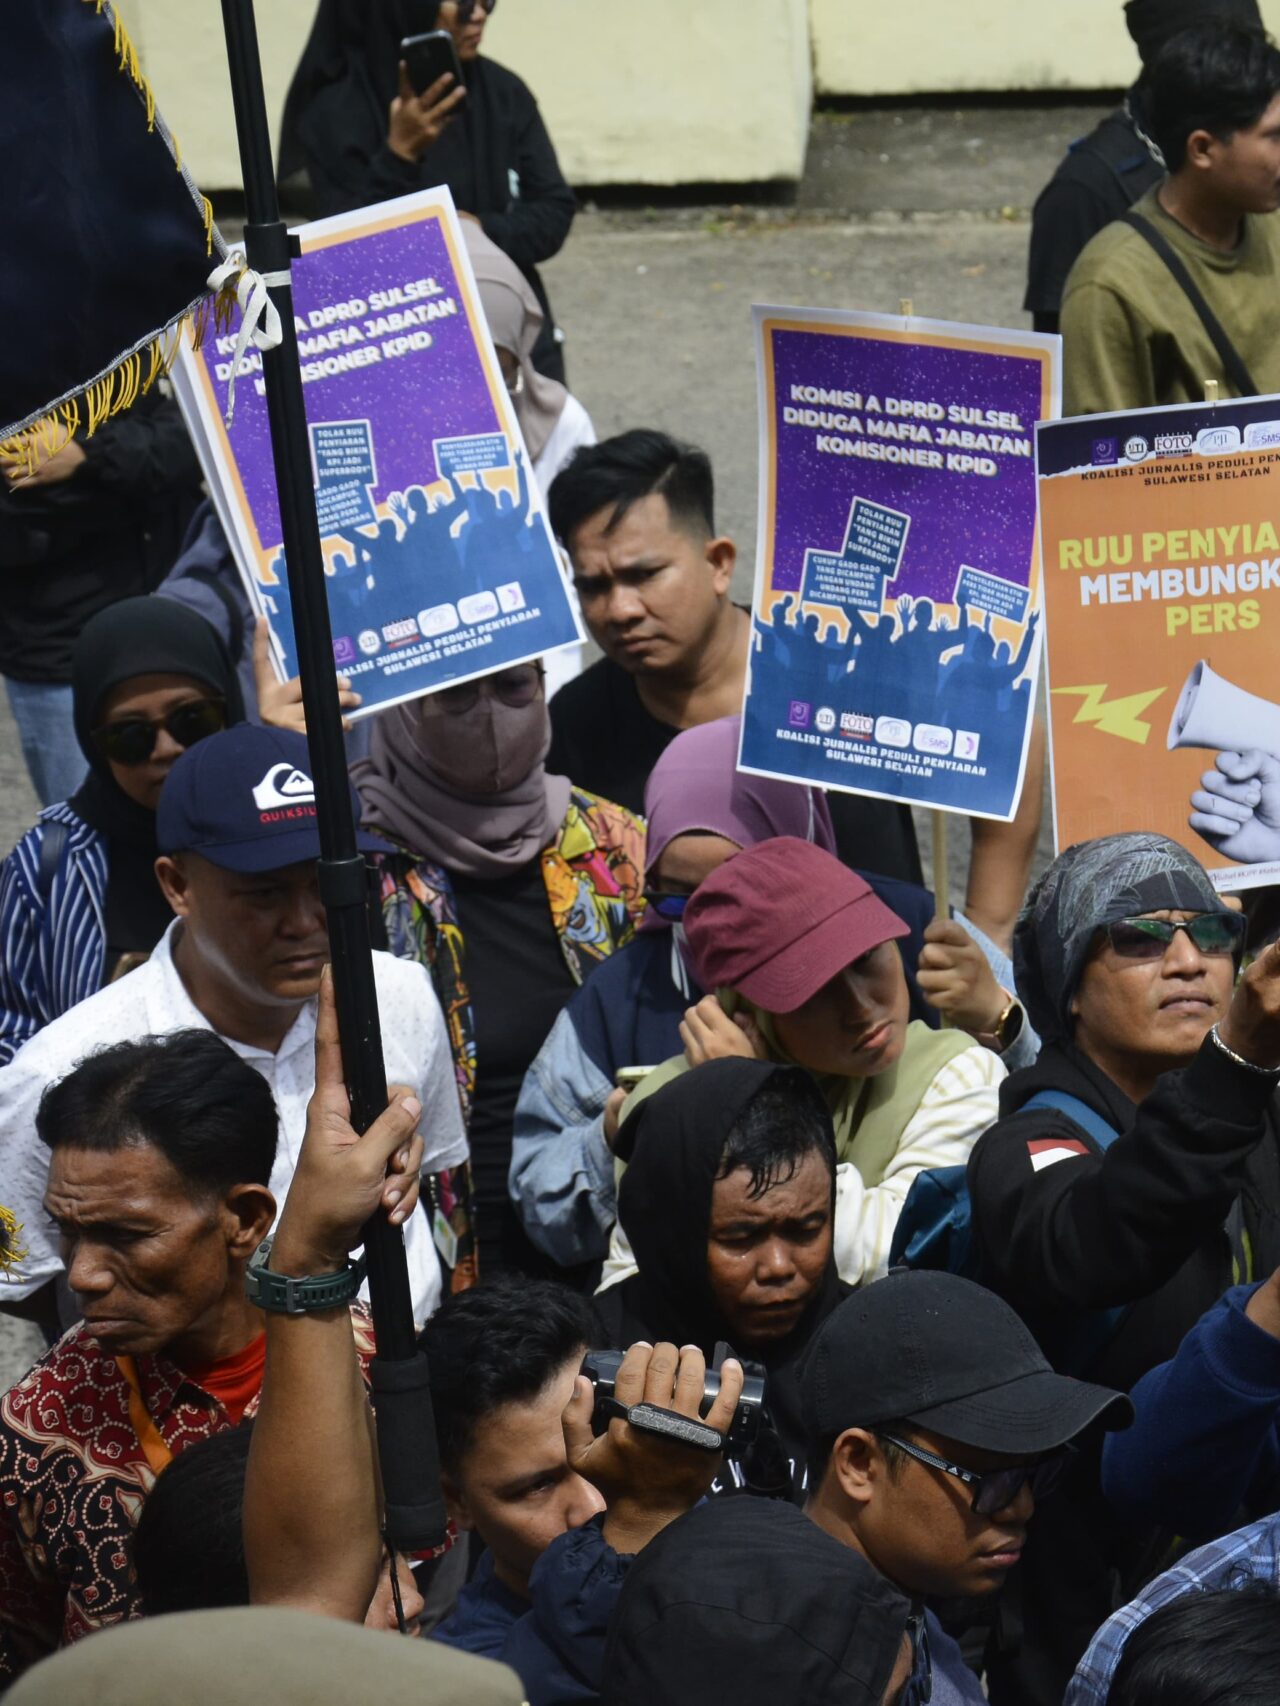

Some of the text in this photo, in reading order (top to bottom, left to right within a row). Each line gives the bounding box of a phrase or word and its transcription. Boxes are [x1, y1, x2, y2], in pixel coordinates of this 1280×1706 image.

[308, 299, 367, 329] DPRD
[368, 277, 445, 311] SULSEL
[297, 325, 365, 358] MAFIA
[364, 297, 458, 339] JABATAN
[254, 343, 381, 396] KISIONER
[381, 331, 433, 358] KPID
[790, 384, 1024, 431] KOMISI A DPRD SULSEL
[317, 429, 347, 438] TOLAK
[783, 407, 1031, 457] DIDUGA MAFIA JABATAN
[1157, 436, 1192, 450] FOTO
[327, 457, 362, 466] KPI JADI
[816, 434, 998, 476] KOMISIONER KPID
[1081, 466, 1134, 481] KOALISI
[1138, 461, 1203, 476] JURNALIS
[1208, 456, 1254, 471] PEDULI
[1144, 466, 1271, 486] SULAWESI SELATAN
[856, 515, 900, 537] PENYIARAN
[859, 506, 903, 528] TOLAK RUU
[858, 535, 890, 553] KPI JADI
[879, 533, 900, 547] BIKIN
[1059, 534, 1133, 570] RUU
[813, 556, 881, 573] CUKUP GADO GADO
[816, 565, 835, 574] YANG
[815, 574, 875, 590] JANGAN UNDANG
[820, 583, 869, 598] UNDANG PERS
[809, 590, 878, 608] DICAMPUR UNDANG
[1001, 601, 1013, 610] ADA
[993, 605, 1008, 616] PERS
[1166, 598, 1261, 637] PERS
[336, 657, 375, 678] OALISI
[376, 641, 433, 667] JURNALIS
[434, 627, 477, 649] PEDULI
[478, 607, 542, 634] PENYIARAN
[383, 634, 493, 676] SULAWESI SELATAN
[842, 714, 873, 731] FOTO
[776, 728, 820, 746] KOALISI
[823, 737, 878, 756] JURNALIS
[880, 748, 920, 765] PEDULI
[923, 756, 987, 777] PENYIARAN
[825, 749, 933, 778] SULAWESI SELATAN
